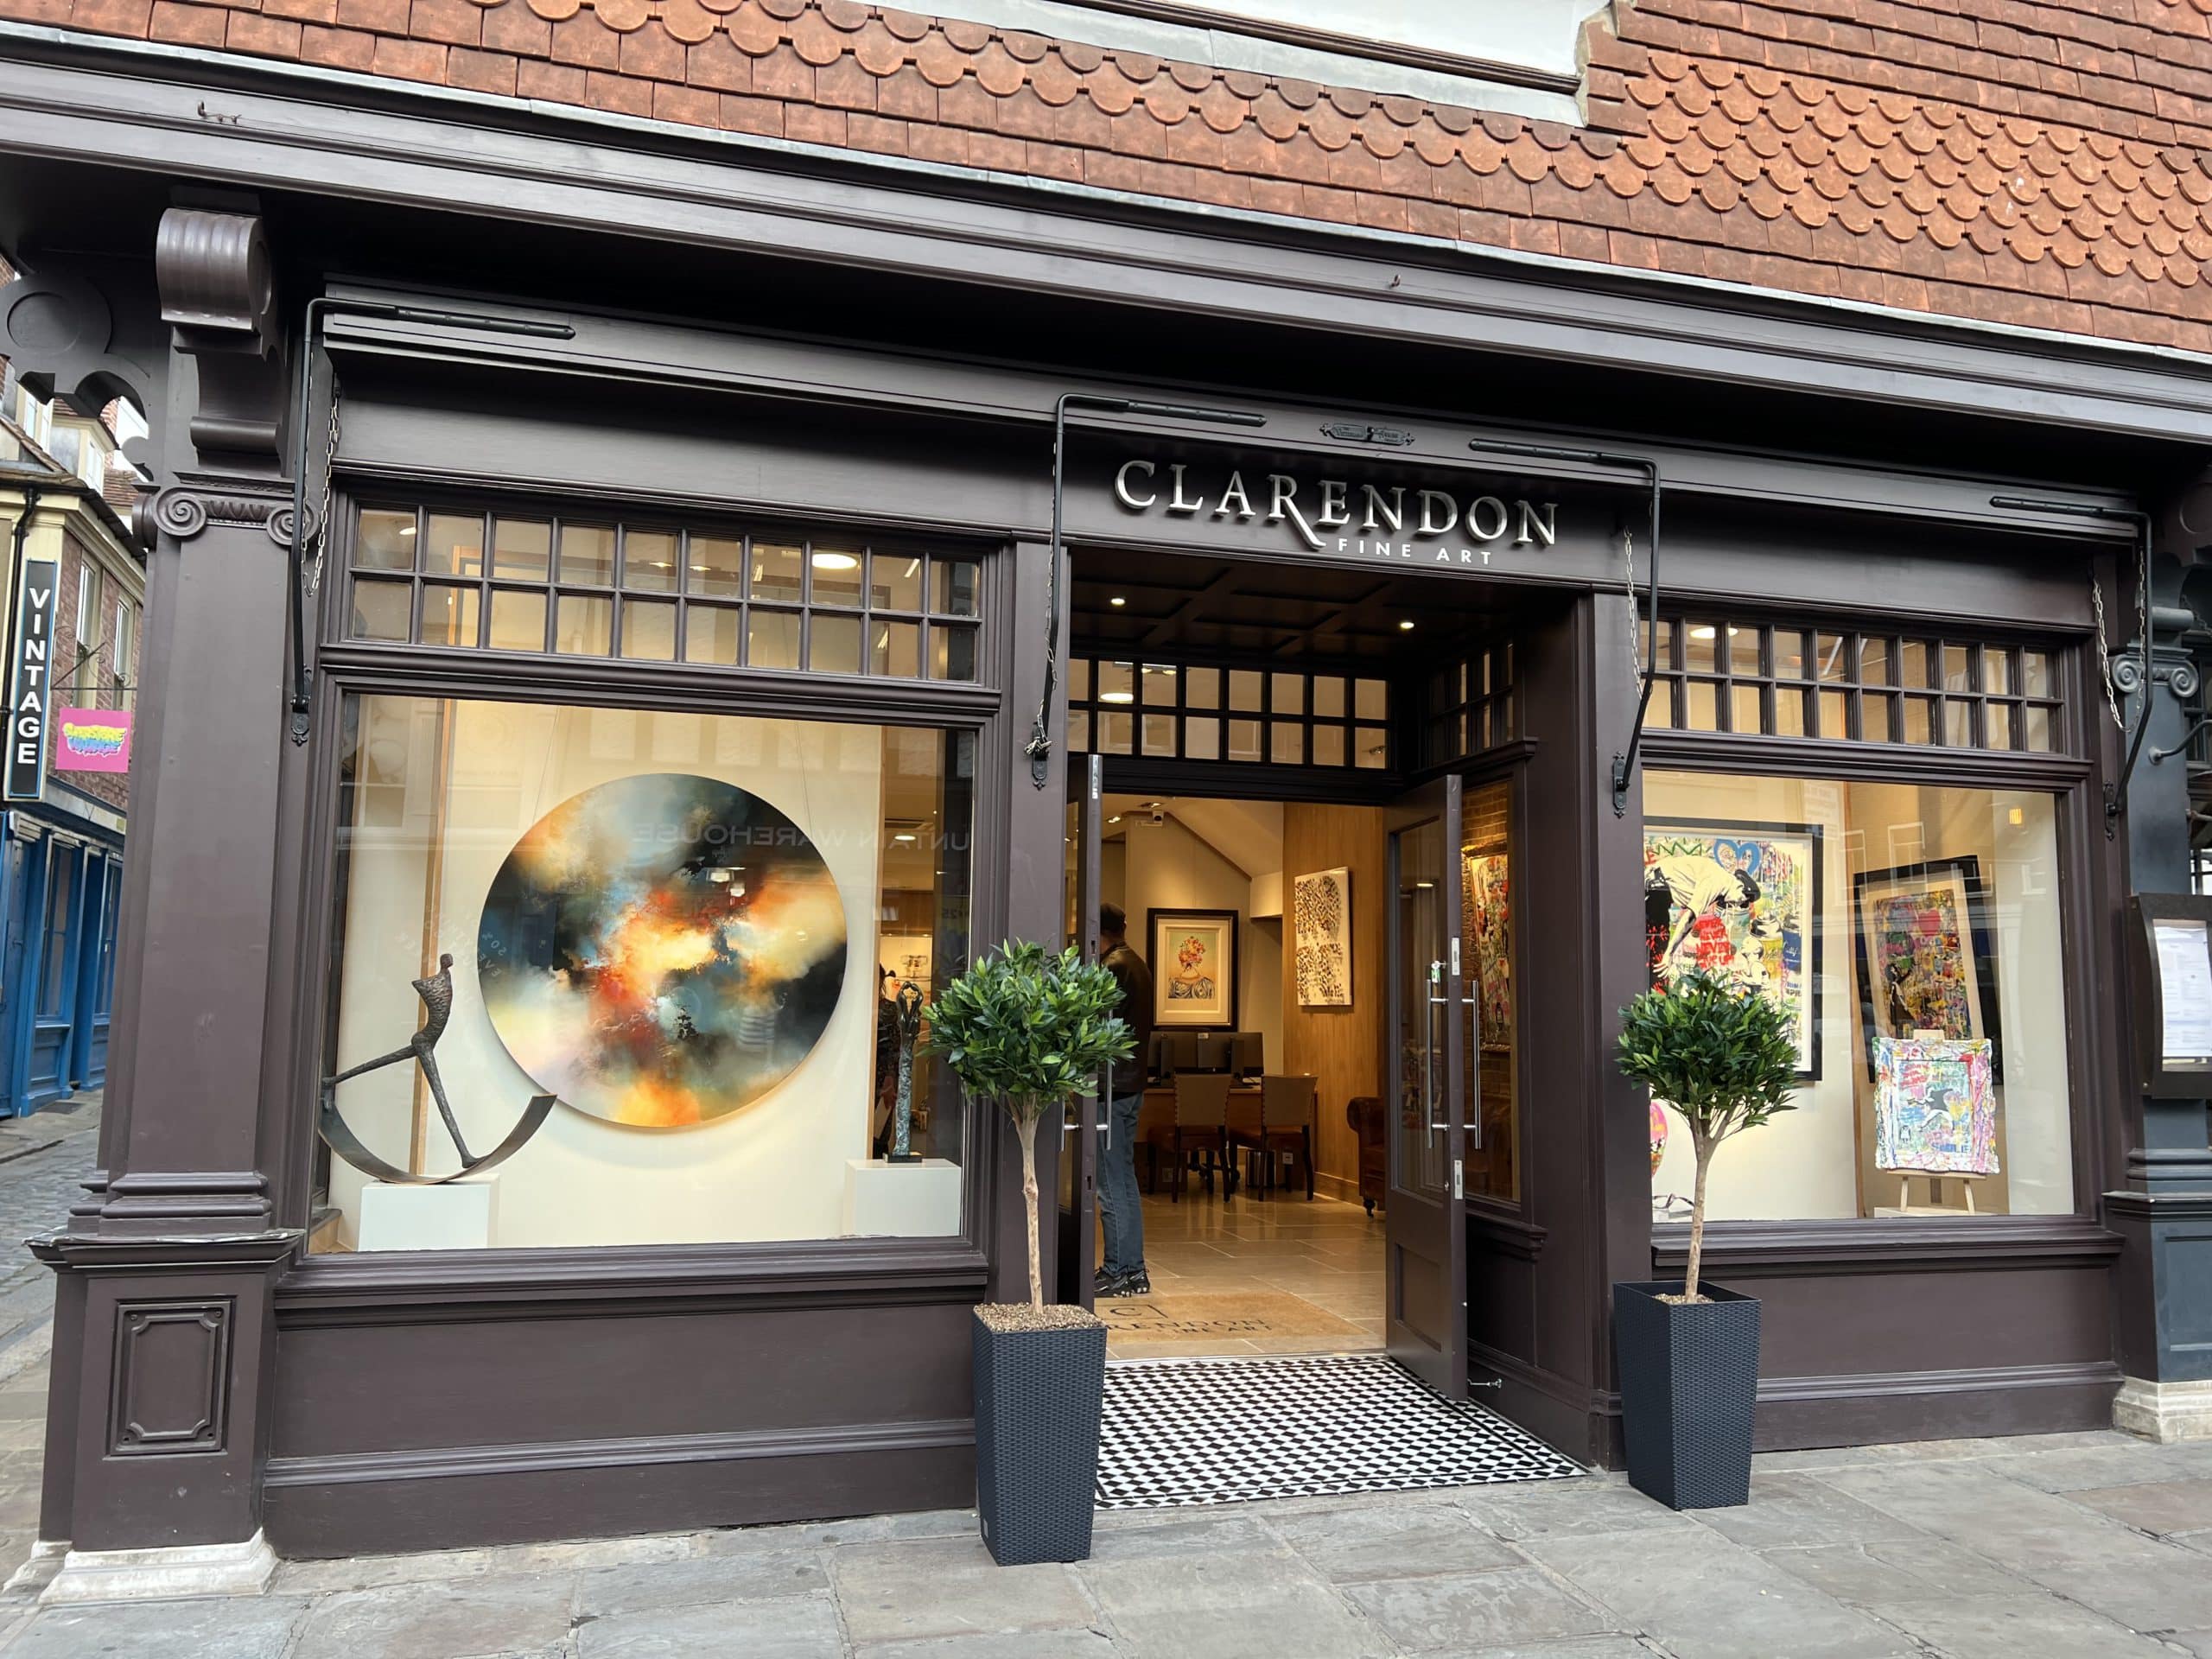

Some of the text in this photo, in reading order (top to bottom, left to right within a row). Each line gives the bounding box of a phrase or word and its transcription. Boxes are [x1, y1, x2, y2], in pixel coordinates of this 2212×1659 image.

[1115, 460, 1558, 550] CLARENDON
[1338, 537, 1492, 565] FINE ART
[17, 587, 51, 765] VINTAGE
